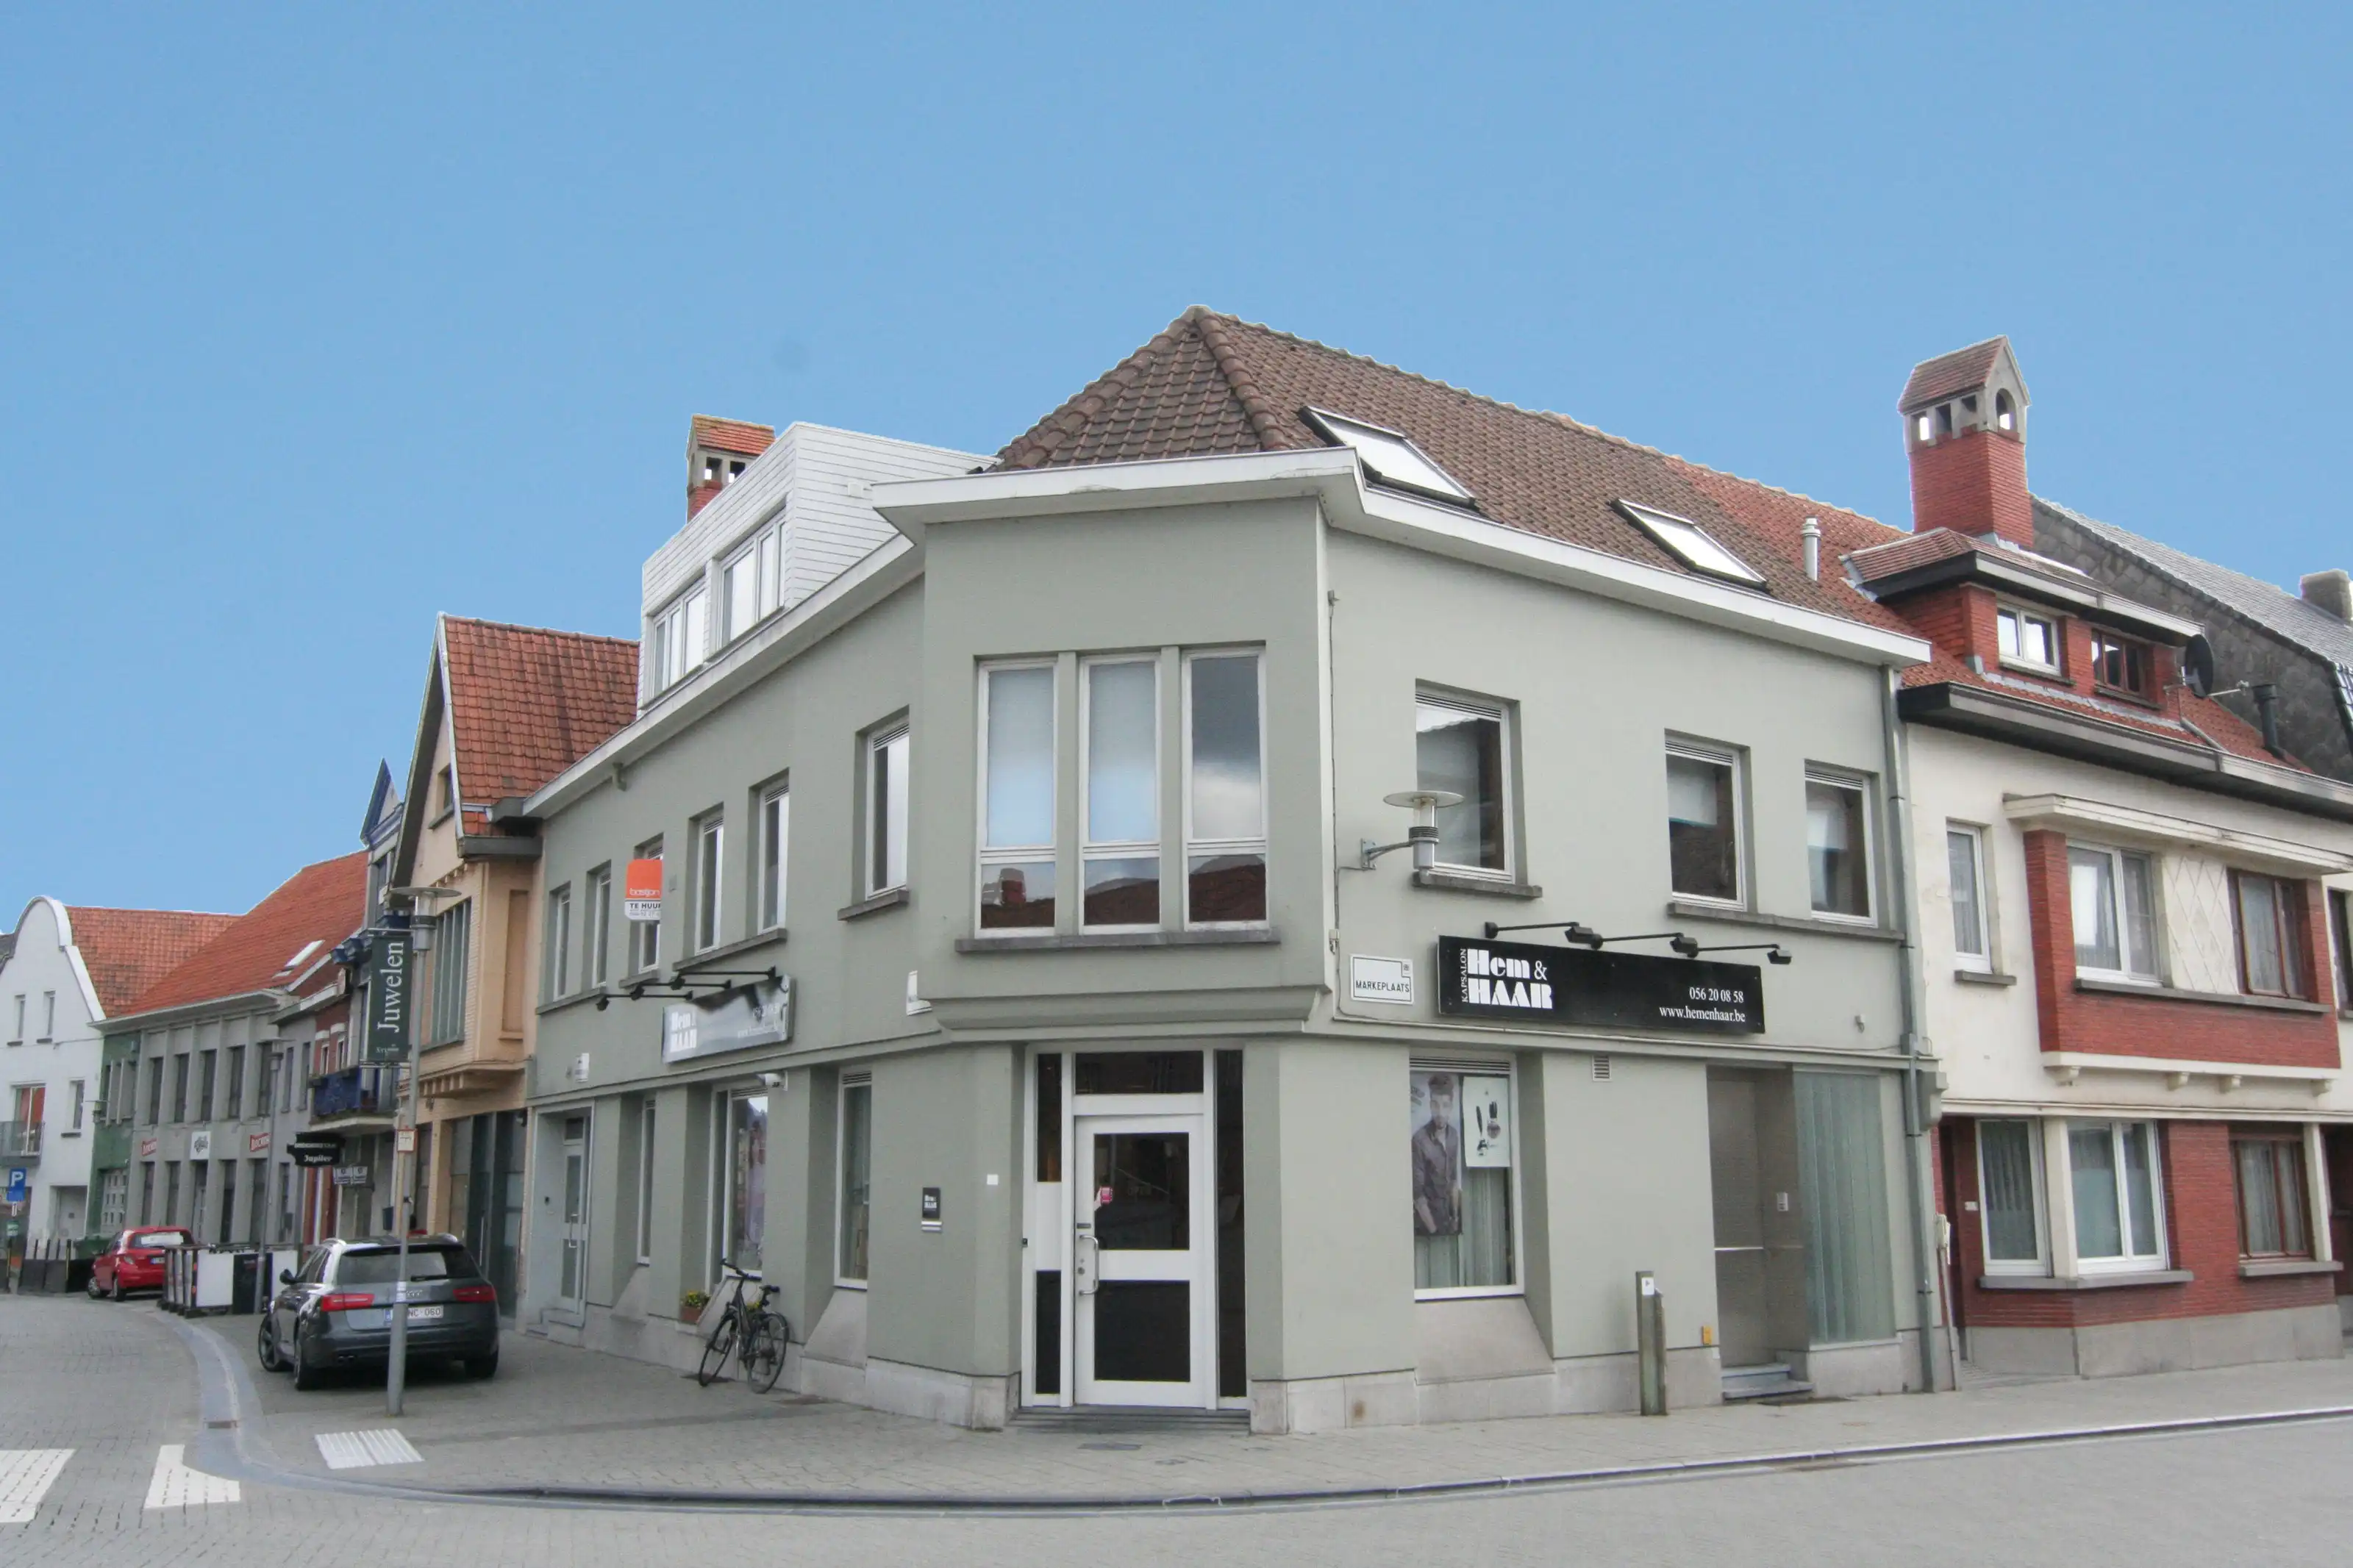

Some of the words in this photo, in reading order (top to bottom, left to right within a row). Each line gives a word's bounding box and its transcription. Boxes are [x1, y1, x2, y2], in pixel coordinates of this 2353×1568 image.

[1460, 948, 1468, 1003] KAPSALON
[1467, 948, 1531, 979] Hem
[1534, 960, 1548, 981] &
[377, 942, 404, 1033] Juwelen
[1355, 980, 1410, 992] MARKEPLAATS
[1468, 978, 1553, 1009] HAAR
[1689, 987, 1707, 1000] 056
[1708, 988, 1719, 1001] 20
[1720, 989, 1732, 1003] 08
[1733, 990, 1744, 1003] 58
[1659, 1005, 1746, 1023] www.hemenhaar.be
[11, 1171, 24, 1186] P
